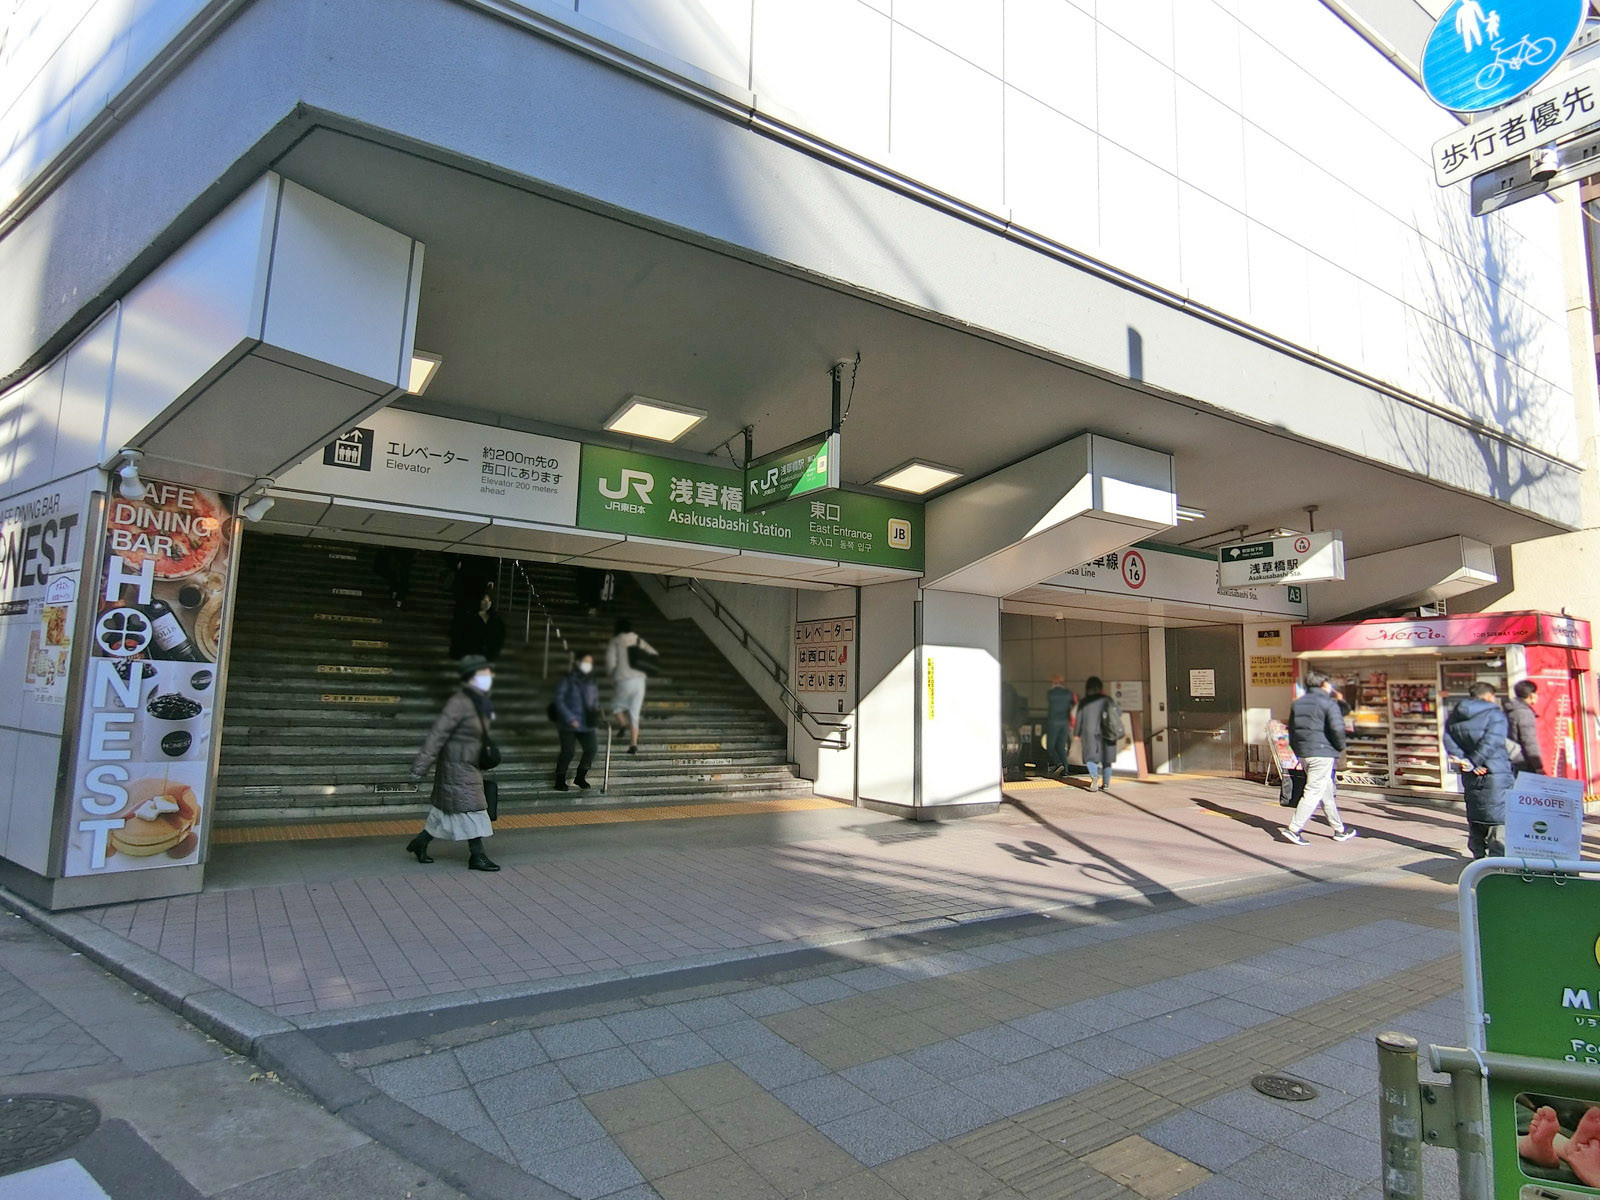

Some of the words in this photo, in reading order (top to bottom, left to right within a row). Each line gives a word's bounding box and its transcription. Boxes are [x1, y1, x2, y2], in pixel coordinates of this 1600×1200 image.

[1441, 85, 1595, 175] 歩行者優先
[386, 441, 470, 464] エレベーター
[482, 446, 559, 470] 約200m先の
[386, 458, 431, 475] Elevator
[481, 461, 563, 485] 西口にあります
[481, 476, 514, 489] Elevator
[515, 480, 531, 491] 200
[532, 482, 559, 494] meters
[598, 468, 655, 505] JR
[760, 467, 779, 490] JR
[144, 482, 195, 510] AFE
[480, 485, 506, 496] ahead
[41, 493, 60, 516] BAR
[604, 501, 646, 515] JR東日本
[810, 501, 841, 521] 東口
[115, 503, 211, 537] DINING
[668, 508, 750, 533] Asakusabashi
[752, 520, 792, 539] Station
[809, 521, 830, 535] East
[833, 525, 873, 540] Entrance
[893, 527, 906, 540] JB
[112, 529, 173, 557] BAR
[1130, 557, 1137, 568] A
[1250, 558, 1299, 575] 浅草橋駅
[1081, 568, 1096, 578] Line
[1129, 568, 1140, 581] 16
[1248, 572, 1289, 581] Asakusabashi
[1289, 588, 1300, 601] A3
[796, 624, 852, 640] エレベーター
[800, 650, 835, 663] は西口に
[1518, 795, 1565, 809] 20%OFF
[1524, 833, 1559, 842] MIROKU
[1562, 987, 1600, 1011] M
[1570, 1039, 1600, 1055] FO
